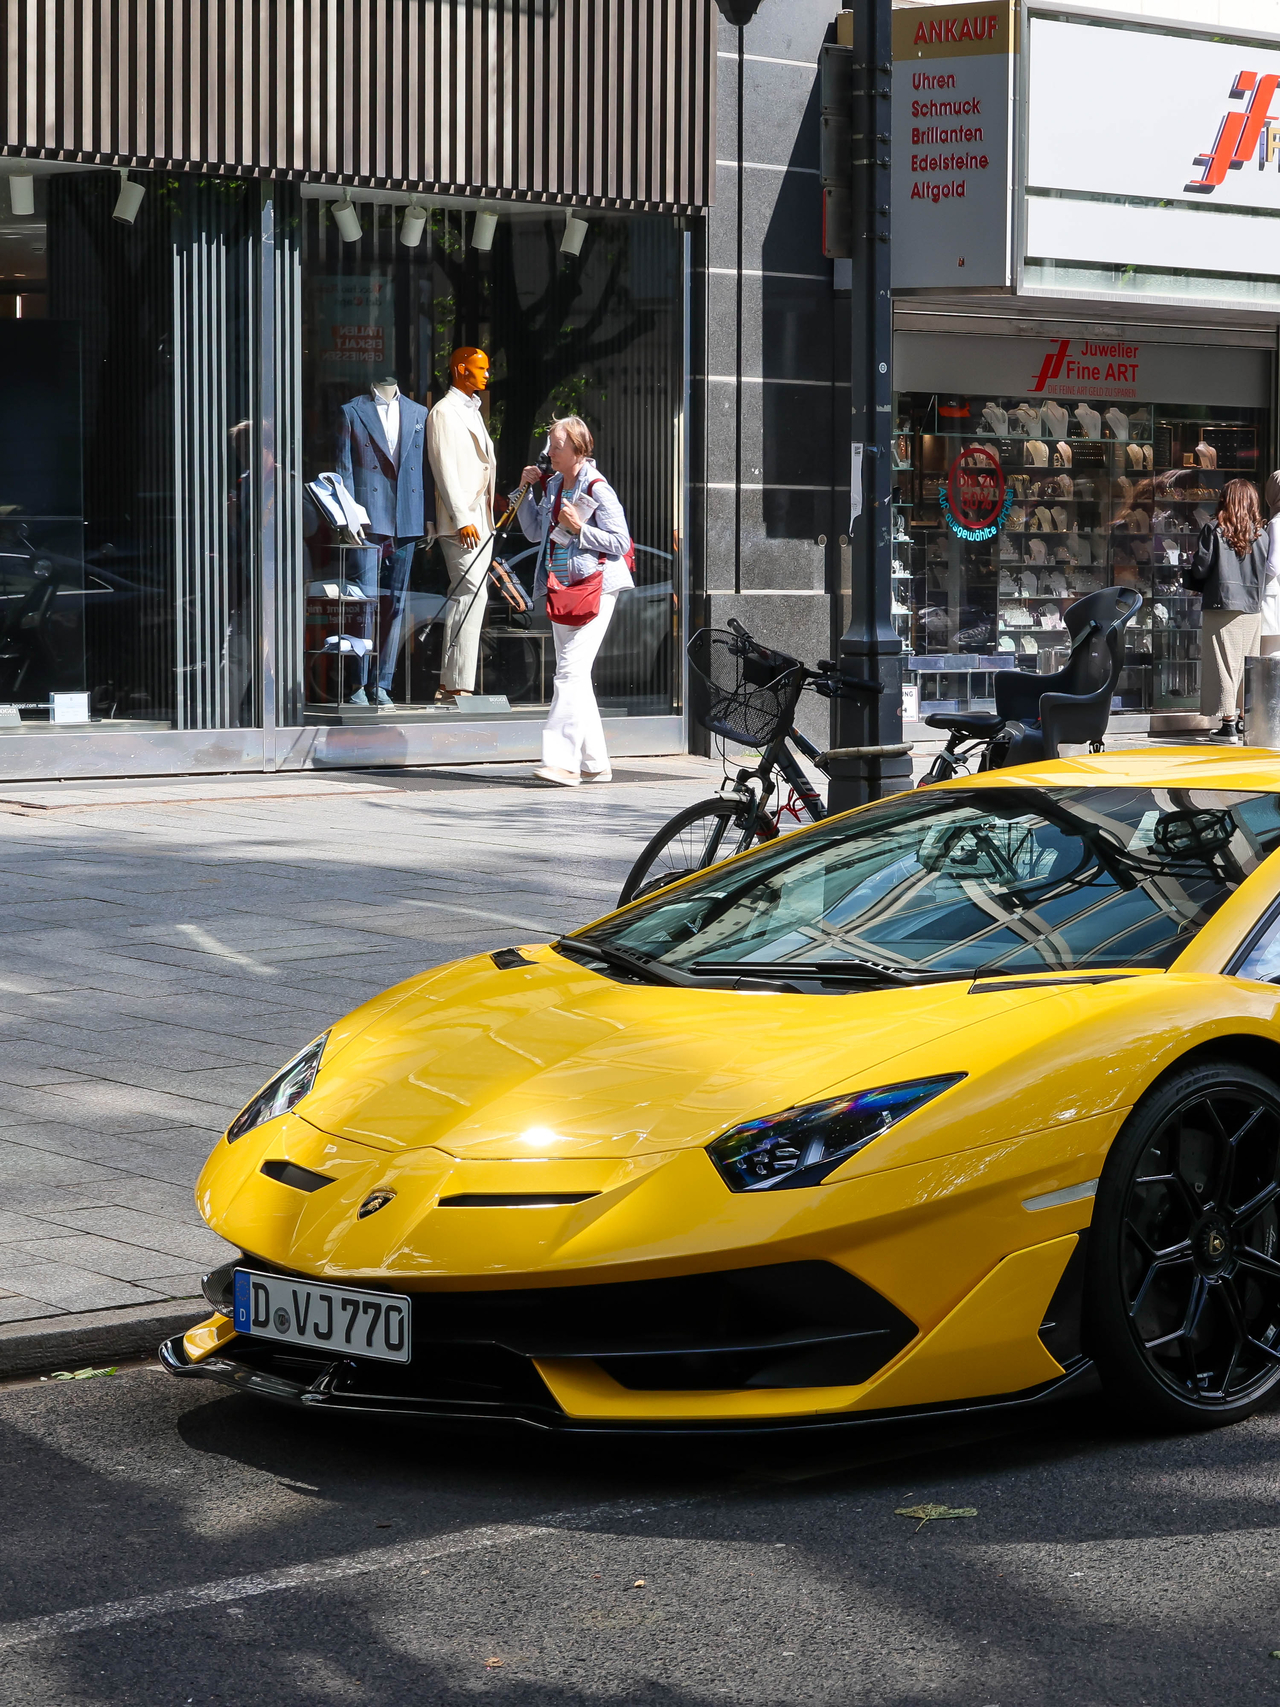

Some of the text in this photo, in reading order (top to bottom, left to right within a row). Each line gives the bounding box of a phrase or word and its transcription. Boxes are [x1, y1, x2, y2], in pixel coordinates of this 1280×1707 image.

[913, 15, 998, 45] ANKAUF
[912, 73, 956, 91] Uhren
[911, 97, 981, 118] Schmuck
[911, 125, 984, 145] Brillanten
[911, 152, 989, 172] Edelsteine
[910, 180, 967, 203] Altgold
[1081, 340, 1139, 359] Juwelier
[1066, 360, 1139, 383] Fine ART
[1047, 384, 1137, 398] DIE FEINE ART GELD ZU SPAREN
[956, 470, 998, 489] Bis zu
[961, 491, 993, 510] 50%
[938, 486, 1014, 541] Auf ausgewählte Artikel
[239, 1308, 247, 1322] D
[251, 1281, 404, 1352] D VJ 770
